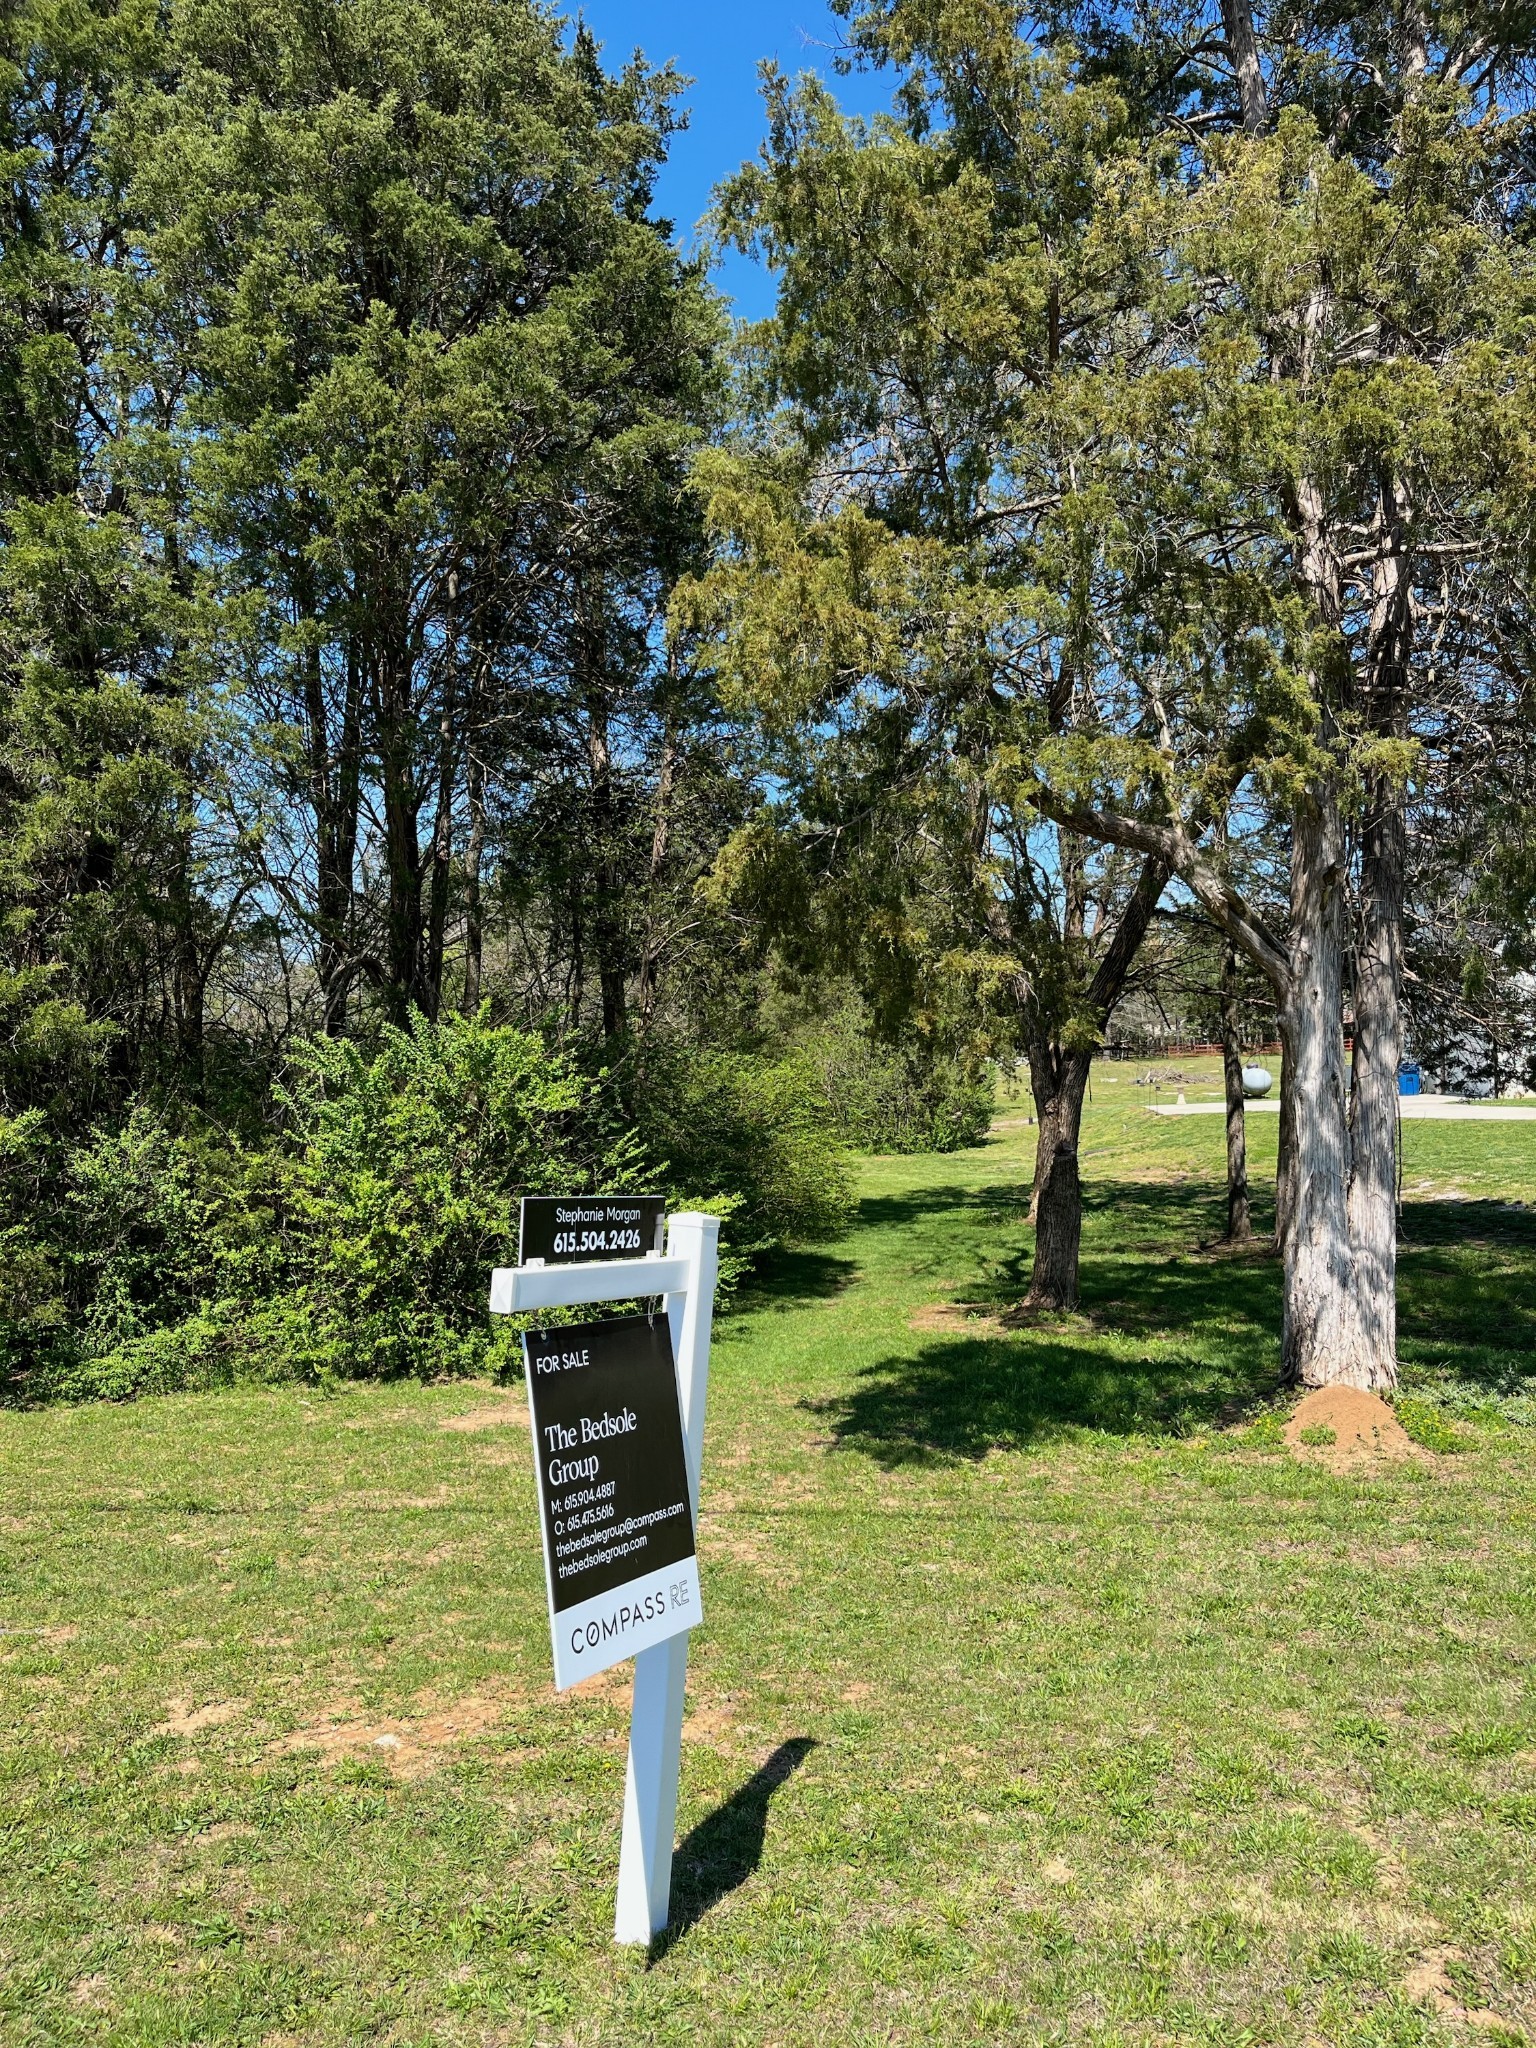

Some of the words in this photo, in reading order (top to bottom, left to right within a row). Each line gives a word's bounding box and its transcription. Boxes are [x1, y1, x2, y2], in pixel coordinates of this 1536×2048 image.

[556, 1206, 604, 1226] Stephanie
[606, 1206, 641, 1224] Morgan
[553, 1229, 641, 1253] 615.504.2426
[536, 1355, 560, 1375] FOR
[562, 1349, 590, 1368] SALE
[544, 1422, 577, 1452] The
[580, 1407, 637, 1444] Bedsole
[549, 1454, 599, 1485] Group
[551, 1498, 563, 1515] M:
[564, 1480, 616, 1511] 615.904.4887
[554, 1520, 566, 1536] O:
[567, 1503, 615, 1532] 615.475.5616
[556, 1501, 685, 1558] thebedsolegroup@compass.com
[558, 1534, 648, 1579] thebedsolegroup.com
[571, 1591, 666, 1655] COMPASS
[669, 1579, 690, 1610] RE
